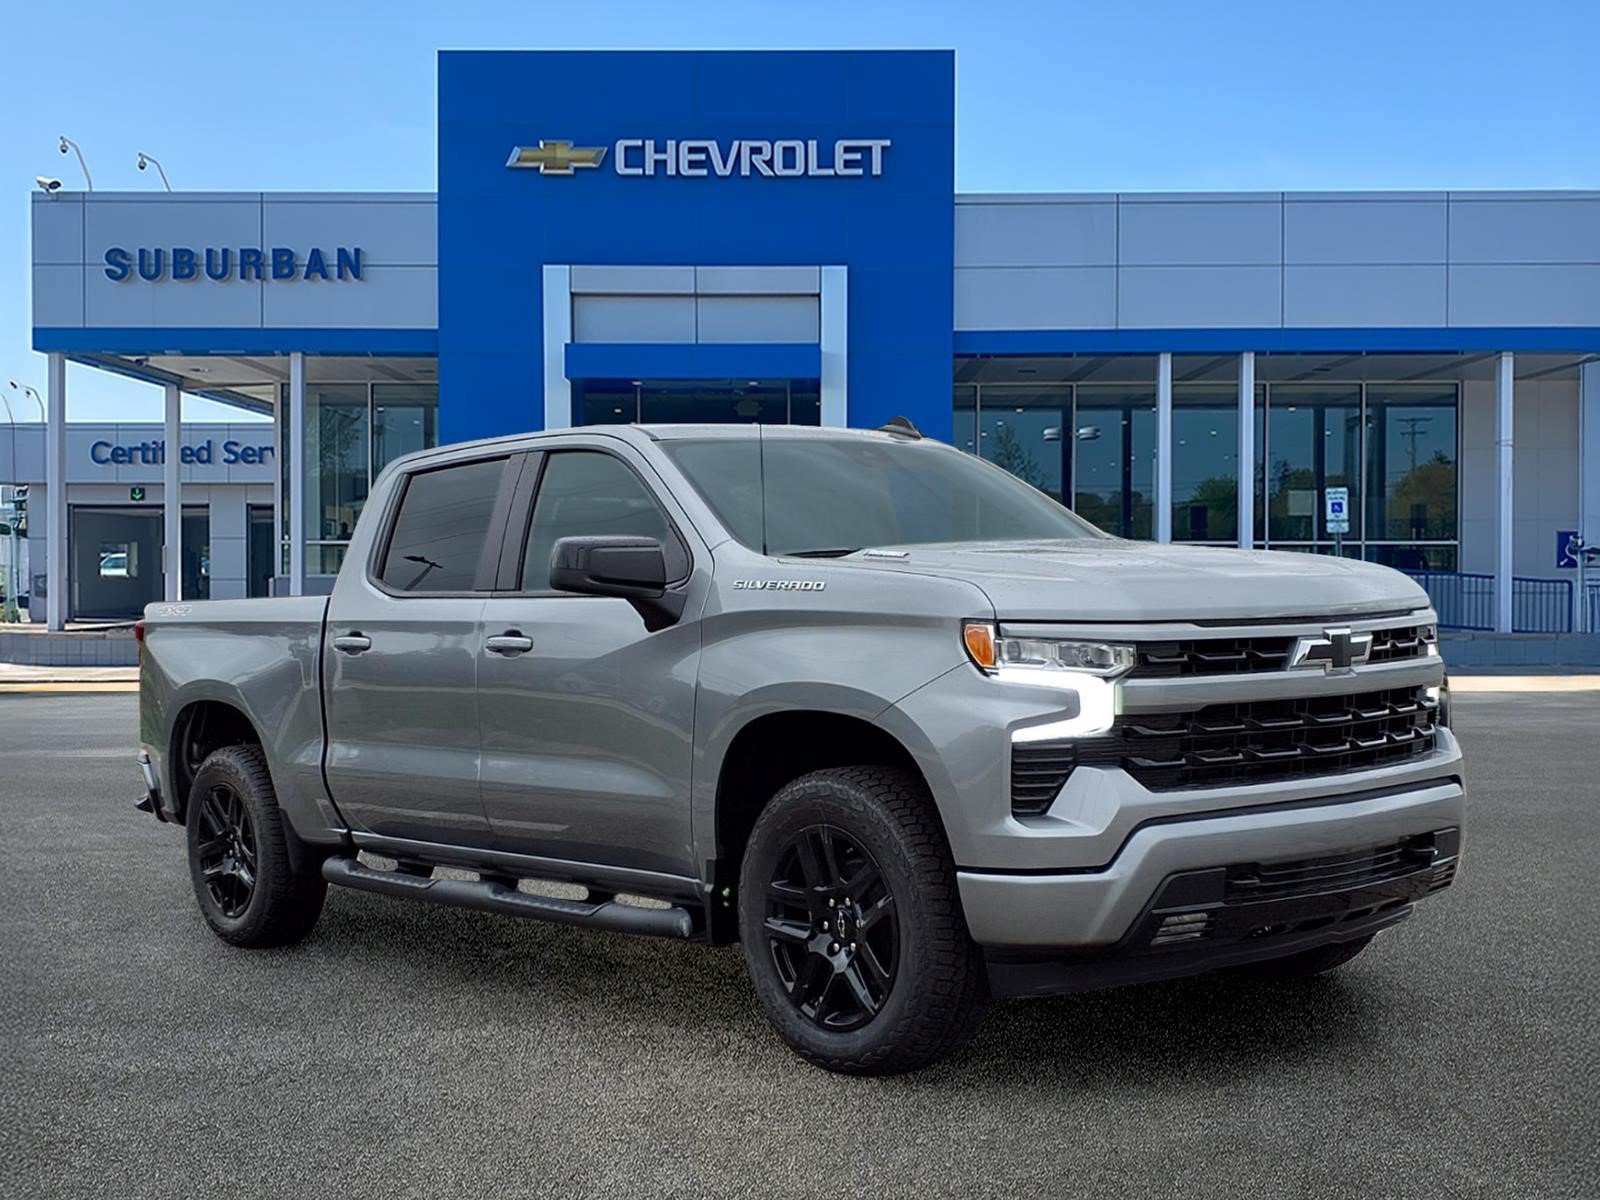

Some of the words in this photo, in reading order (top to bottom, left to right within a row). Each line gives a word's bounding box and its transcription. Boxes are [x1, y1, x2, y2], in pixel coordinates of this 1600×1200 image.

[615, 139, 891, 176] CHEVROLET
[104, 248, 362, 281] SUBURBAN
[91, 440, 212, 464] Certifed
[733, 580, 826, 592] SILVERADO
